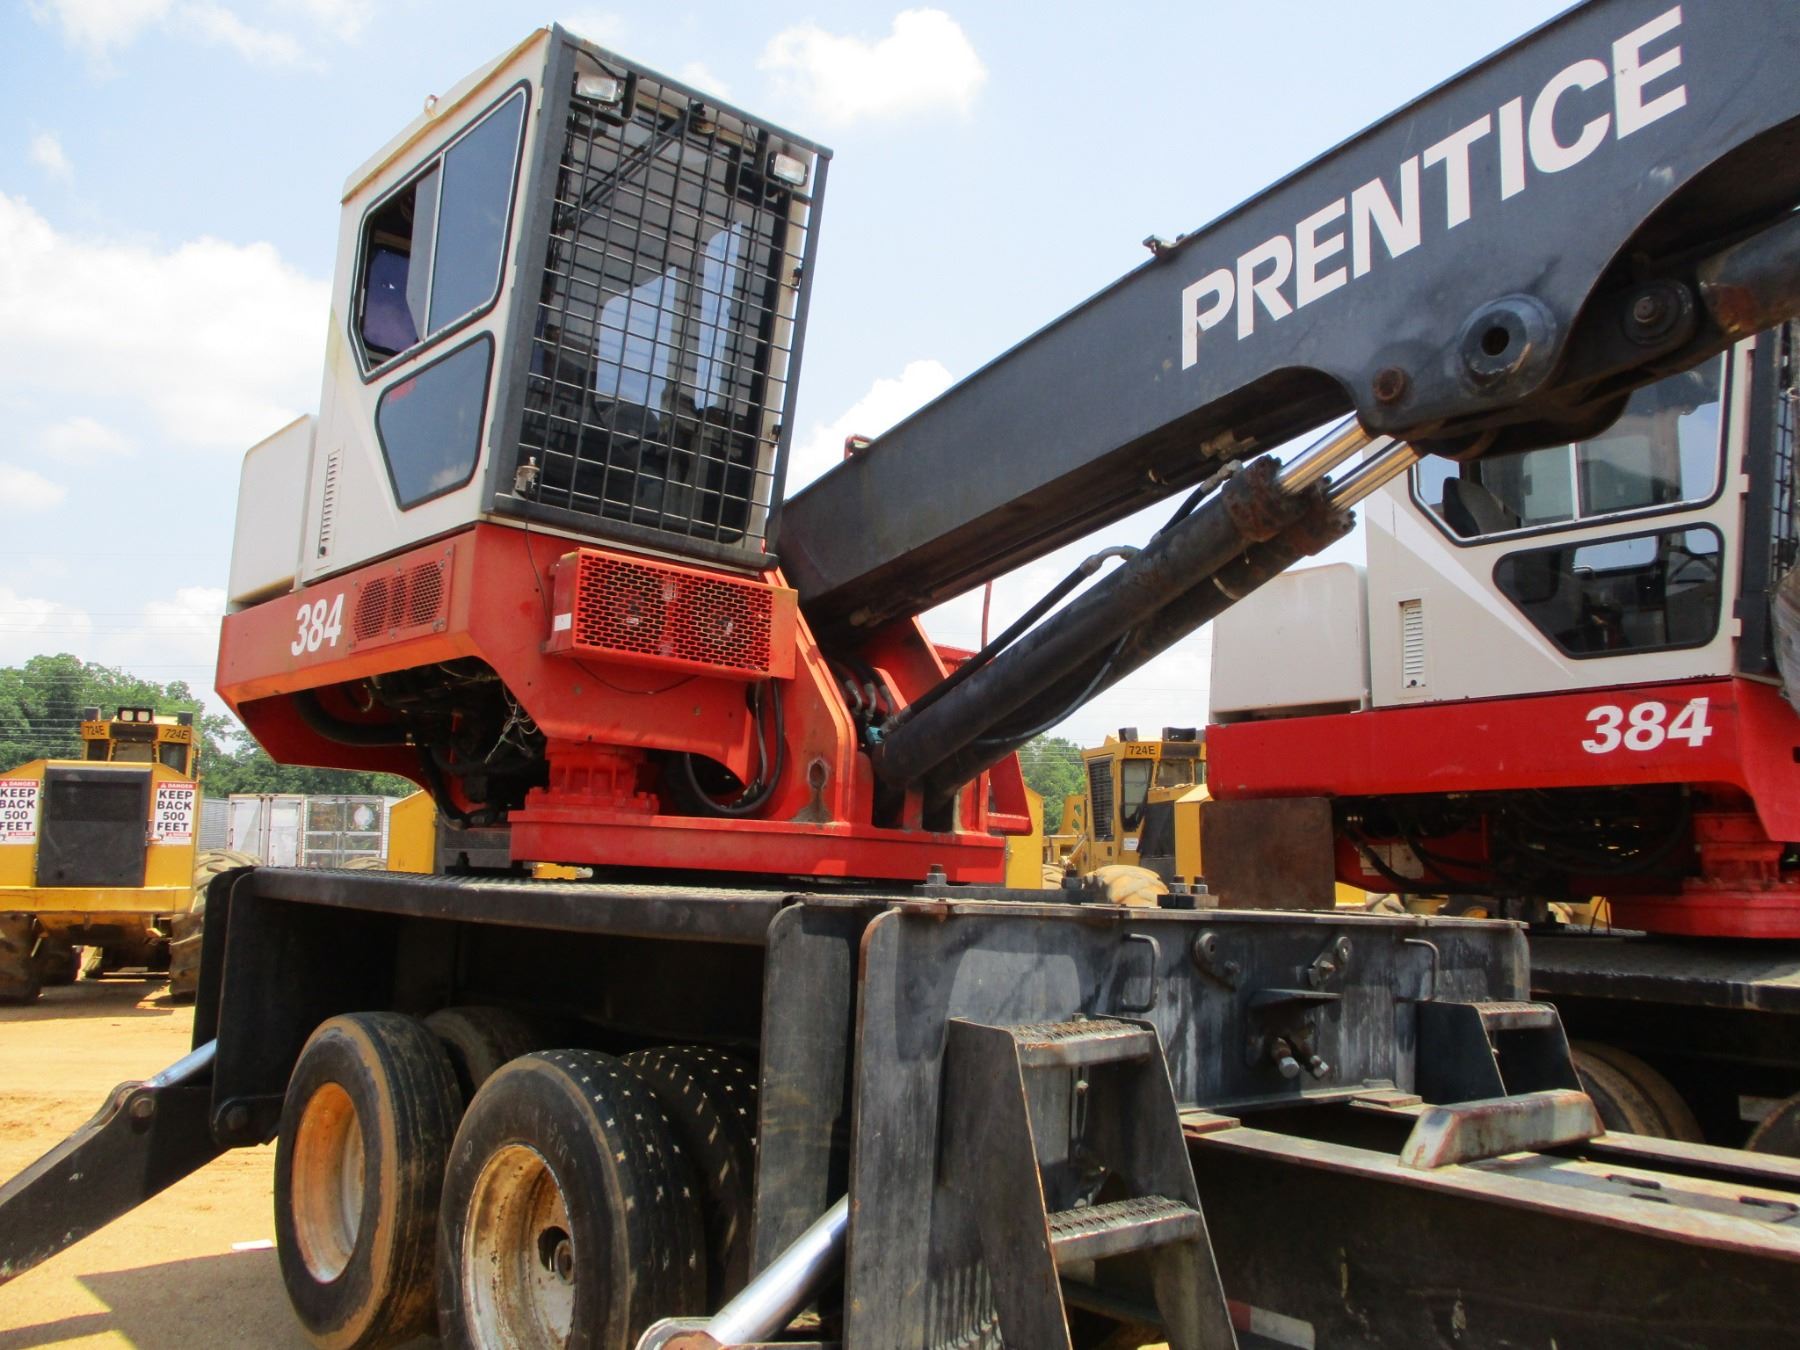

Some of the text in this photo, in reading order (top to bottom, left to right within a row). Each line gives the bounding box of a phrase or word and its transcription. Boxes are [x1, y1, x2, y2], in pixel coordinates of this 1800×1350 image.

[1182, 4, 1687, 371] PRENTICE
[291, 592, 344, 657] 384
[1581, 696, 1713, 754] 384
[85, 725, 105, 736] 724E
[164, 728, 190, 740] 724E
[1128, 745, 1156, 755] 724E
[0, 788, 36, 798] KEEP
[159, 790, 192, 799] KEEP
[0, 799, 35, 809] BACK
[157, 800, 192, 810] BACK
[4, 810, 29, 820] 500
[162, 811, 186, 821] 500
[0, 821, 32, 831] FEET
[157, 822, 189, 831] FEET
